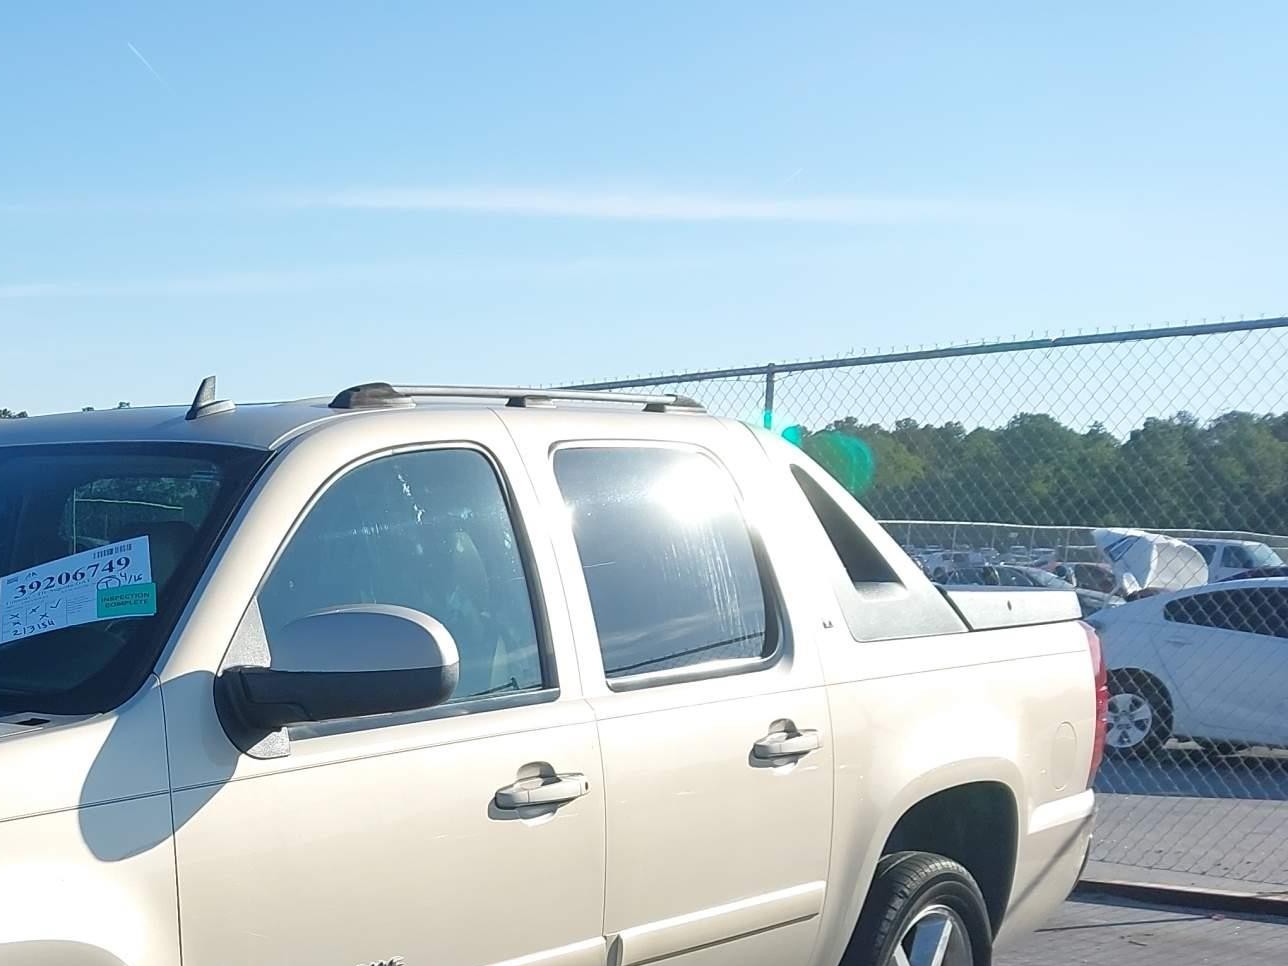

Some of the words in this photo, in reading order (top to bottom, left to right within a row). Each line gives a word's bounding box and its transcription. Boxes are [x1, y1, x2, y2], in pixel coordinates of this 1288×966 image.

[14, 556, 131, 600] 39206749
[101, 591, 150, 602] INSPECTION
[104, 599, 148, 609] COMPLETE
